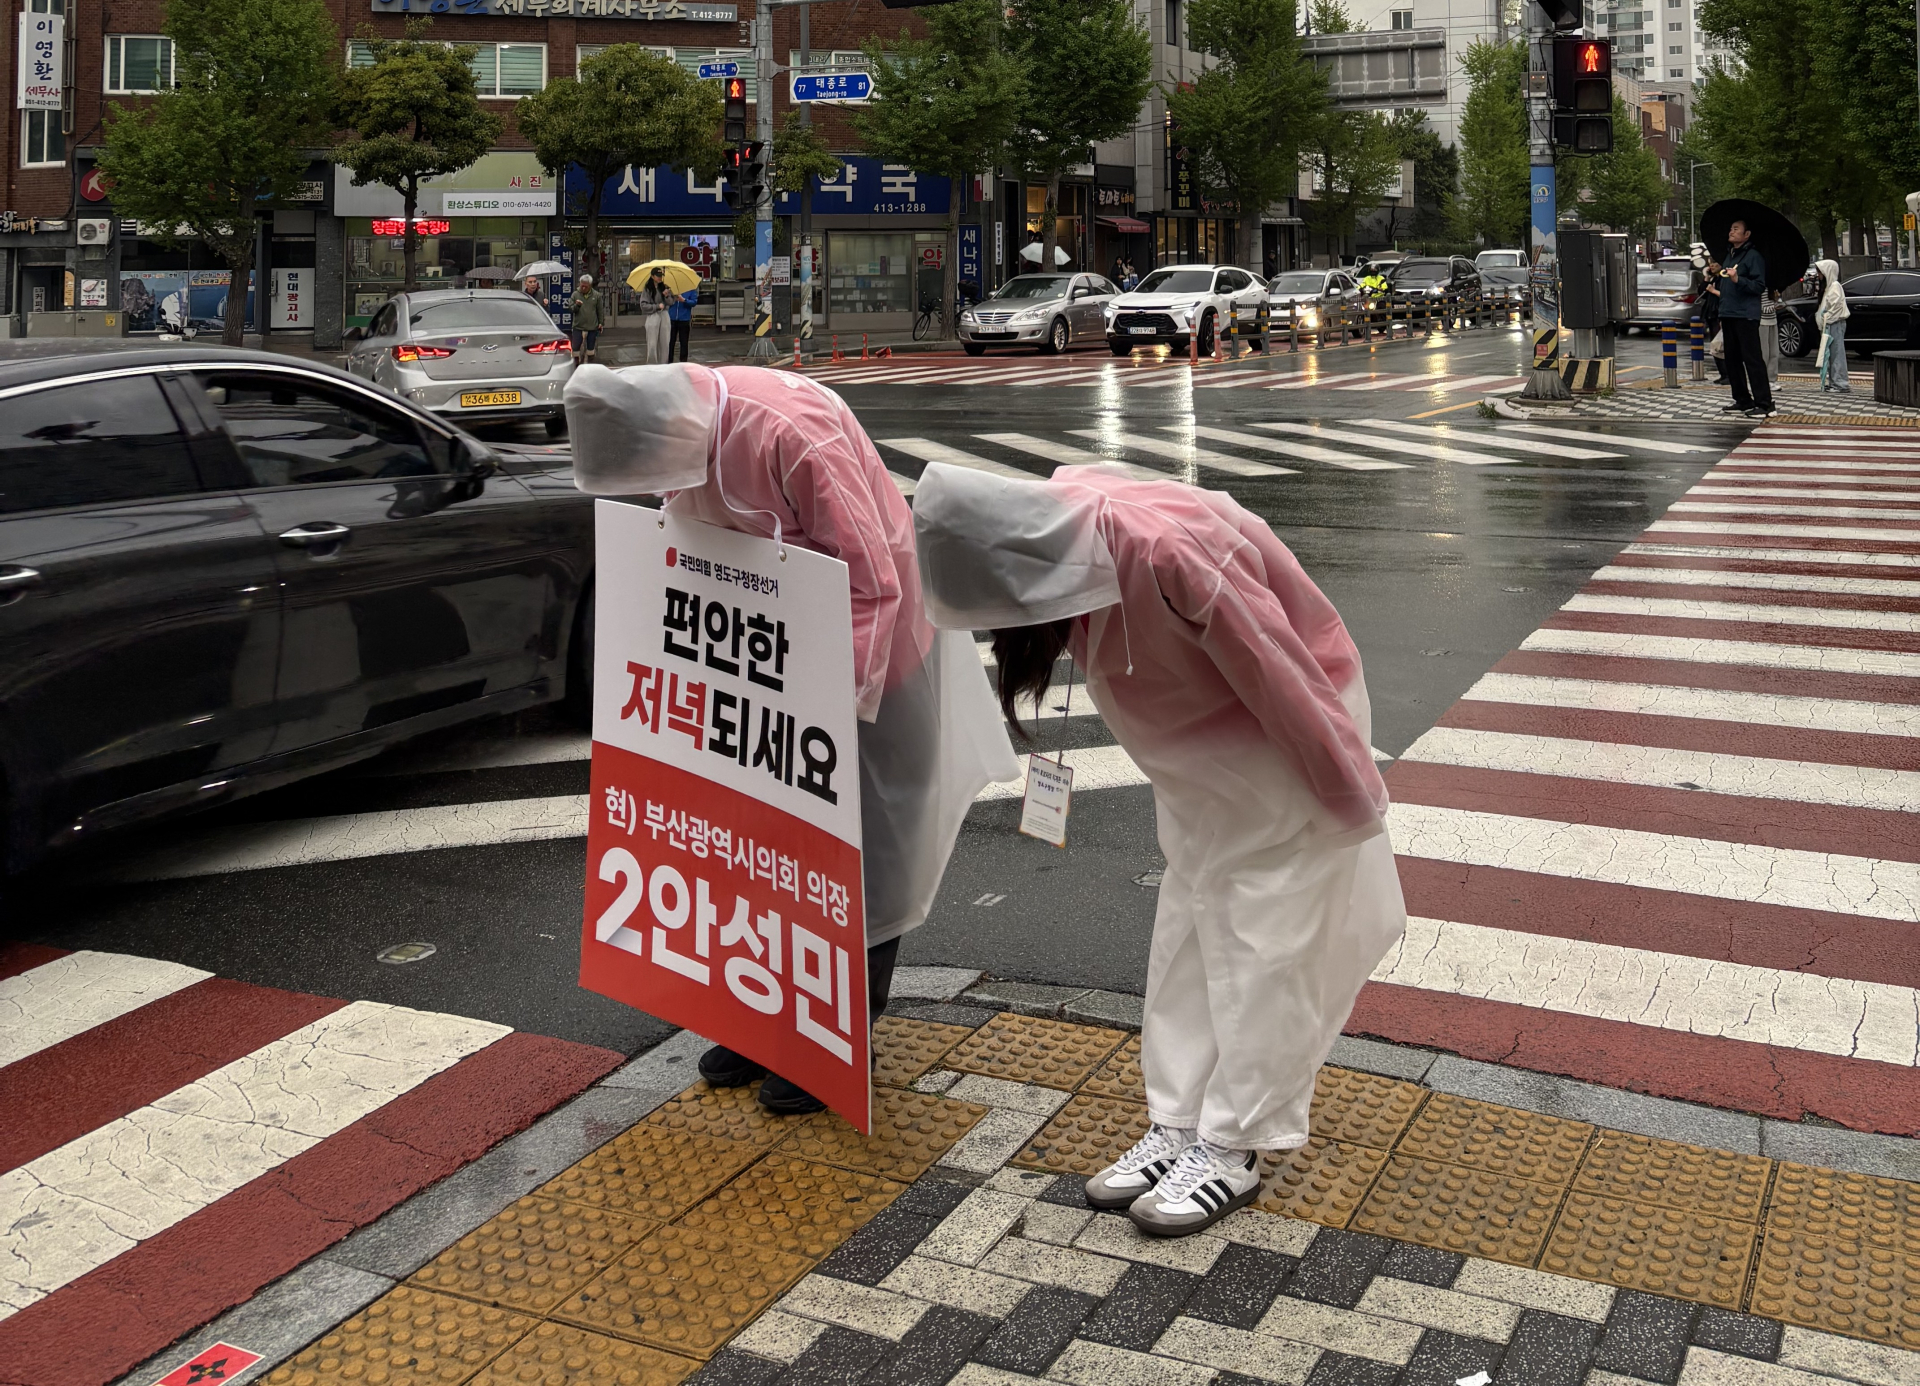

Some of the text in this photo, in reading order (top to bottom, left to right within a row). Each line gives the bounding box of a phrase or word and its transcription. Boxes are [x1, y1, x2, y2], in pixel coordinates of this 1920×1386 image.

[691, 10, 733, 19] T.412-8777
[34, 19, 54, 81] 이영환
[25, 85, 61, 97] 세무사
[798, 77, 866, 93] 77 태종로 81
[816, 90, 848, 99] Taejong-ro
[447, 200, 500, 209] 환상스튜디오
[873, 203, 927, 213] 413-1288
[681, 245, 714, 280] 약
[923, 248, 943, 270] 약
[286, 272, 299, 322] 현대광고사
[492, 393, 517, 404] 6338
[679, 552, 779, 598] 국민의힘 영도구청장선거
[662, 586, 789, 693] 편안한
[620, 660, 838, 806] 저녁되세요
[604, 785, 850, 927] 현) 부산광역시의회 의장
